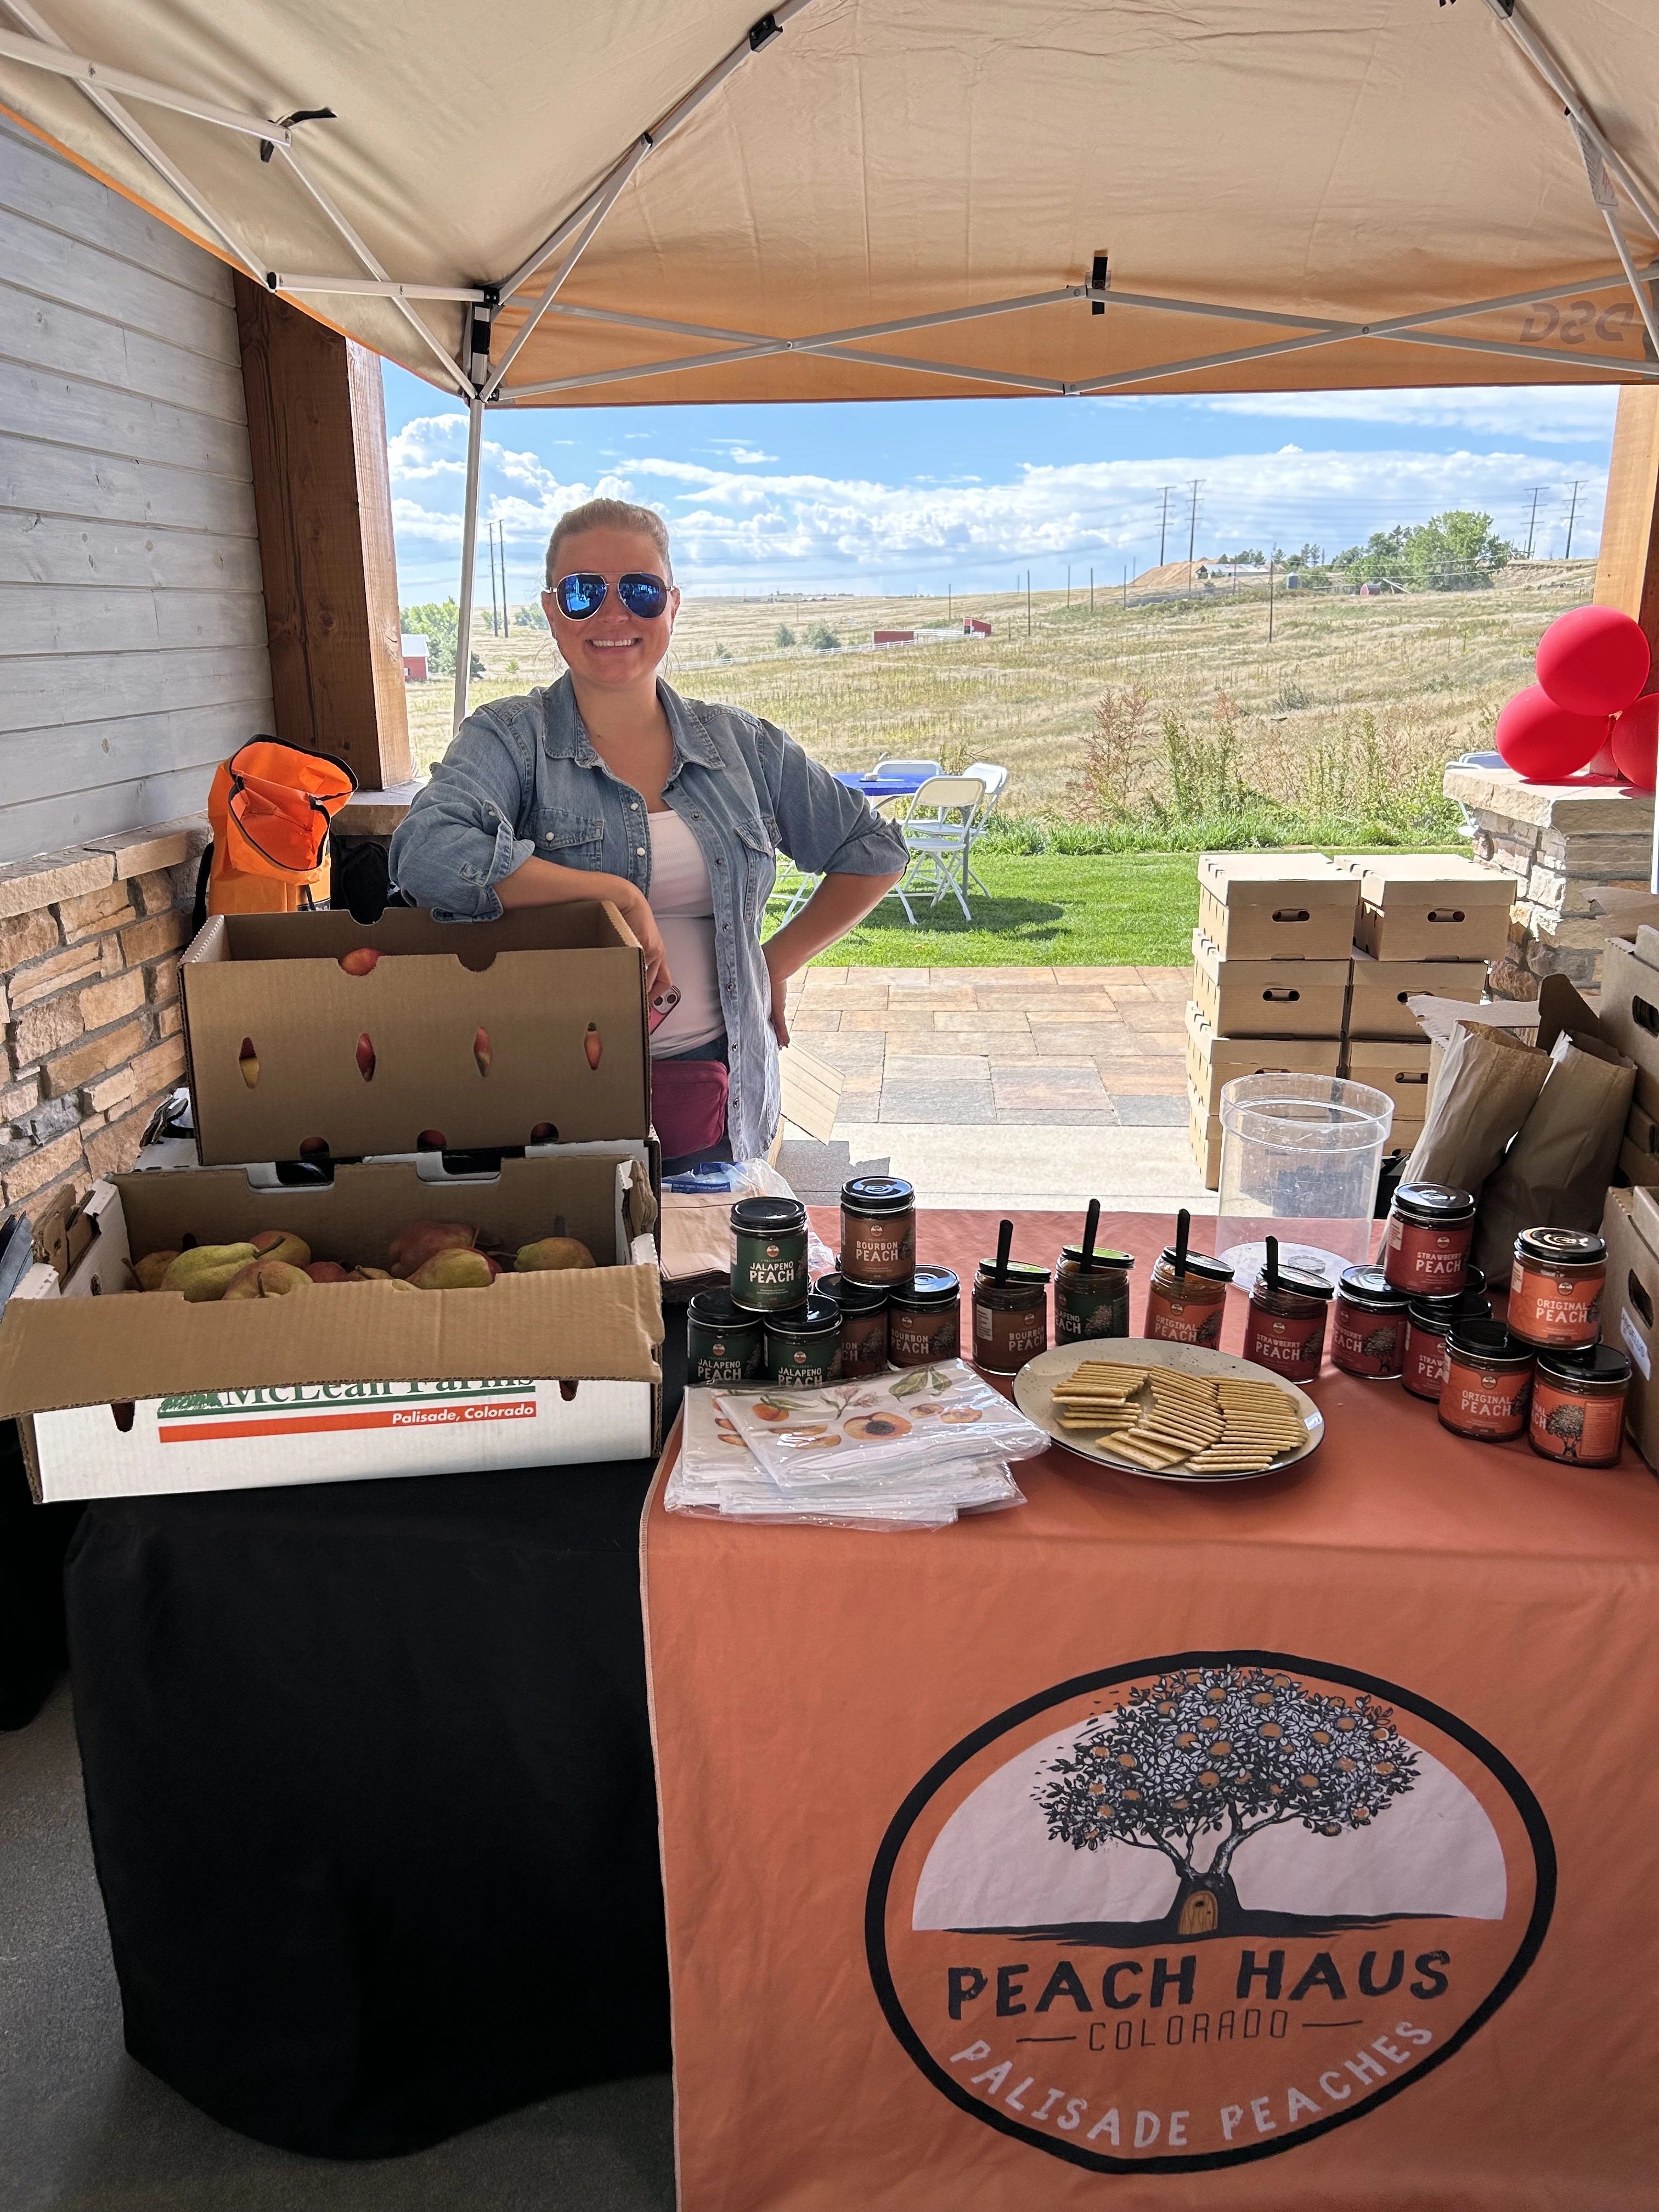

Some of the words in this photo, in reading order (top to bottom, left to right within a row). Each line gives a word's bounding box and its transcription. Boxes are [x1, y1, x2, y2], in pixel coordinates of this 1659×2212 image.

[856, 1240, 898, 1250] BOURBON
[856, 1249, 899, 1262] PEACH
[1417, 1252, 1462, 1261] STRAWBERRY
[750, 1261, 794, 1271] JALAPENO
[1415, 1259, 1462, 1273] PEACH
[749, 1268, 794, 1283] PEACH
[1537, 1298, 1588, 1311] ORIGINAL
[1156, 1314, 1198, 1331] ORIGINAL
[1536, 1307, 1588, 1323] PEACH
[891, 1328, 928, 1343] BOURBON
[1155, 1322, 1197, 1342] PEACH
[891, 1336, 929, 1354] PEACH
[1256, 1334, 1301, 1348] STRAWBERRY
[1256, 1340, 1301, 1361] PEACH
[698, 1358, 741, 1369] JALAPENO
[698, 1365, 741, 1380] PEACH
[778, 1367, 822, 1376] JALAPENO
[1462, 1390, 1513, 1404] ORIGINAL
[392, 1409, 461, 1424] Palisade,
[465, 1404, 534, 1419] Colorado
[1461, 1398, 1511, 1416] PEACH
[948, 1955, 1197, 2020] PEACH
[1236, 1950, 1451, 2000] HAUS
[1089, 2009, 1289, 2051] COLORADO
[950, 2039, 1190, 2148] PALISADE
[1220, 2022, 1433, 2140] PEACHES
